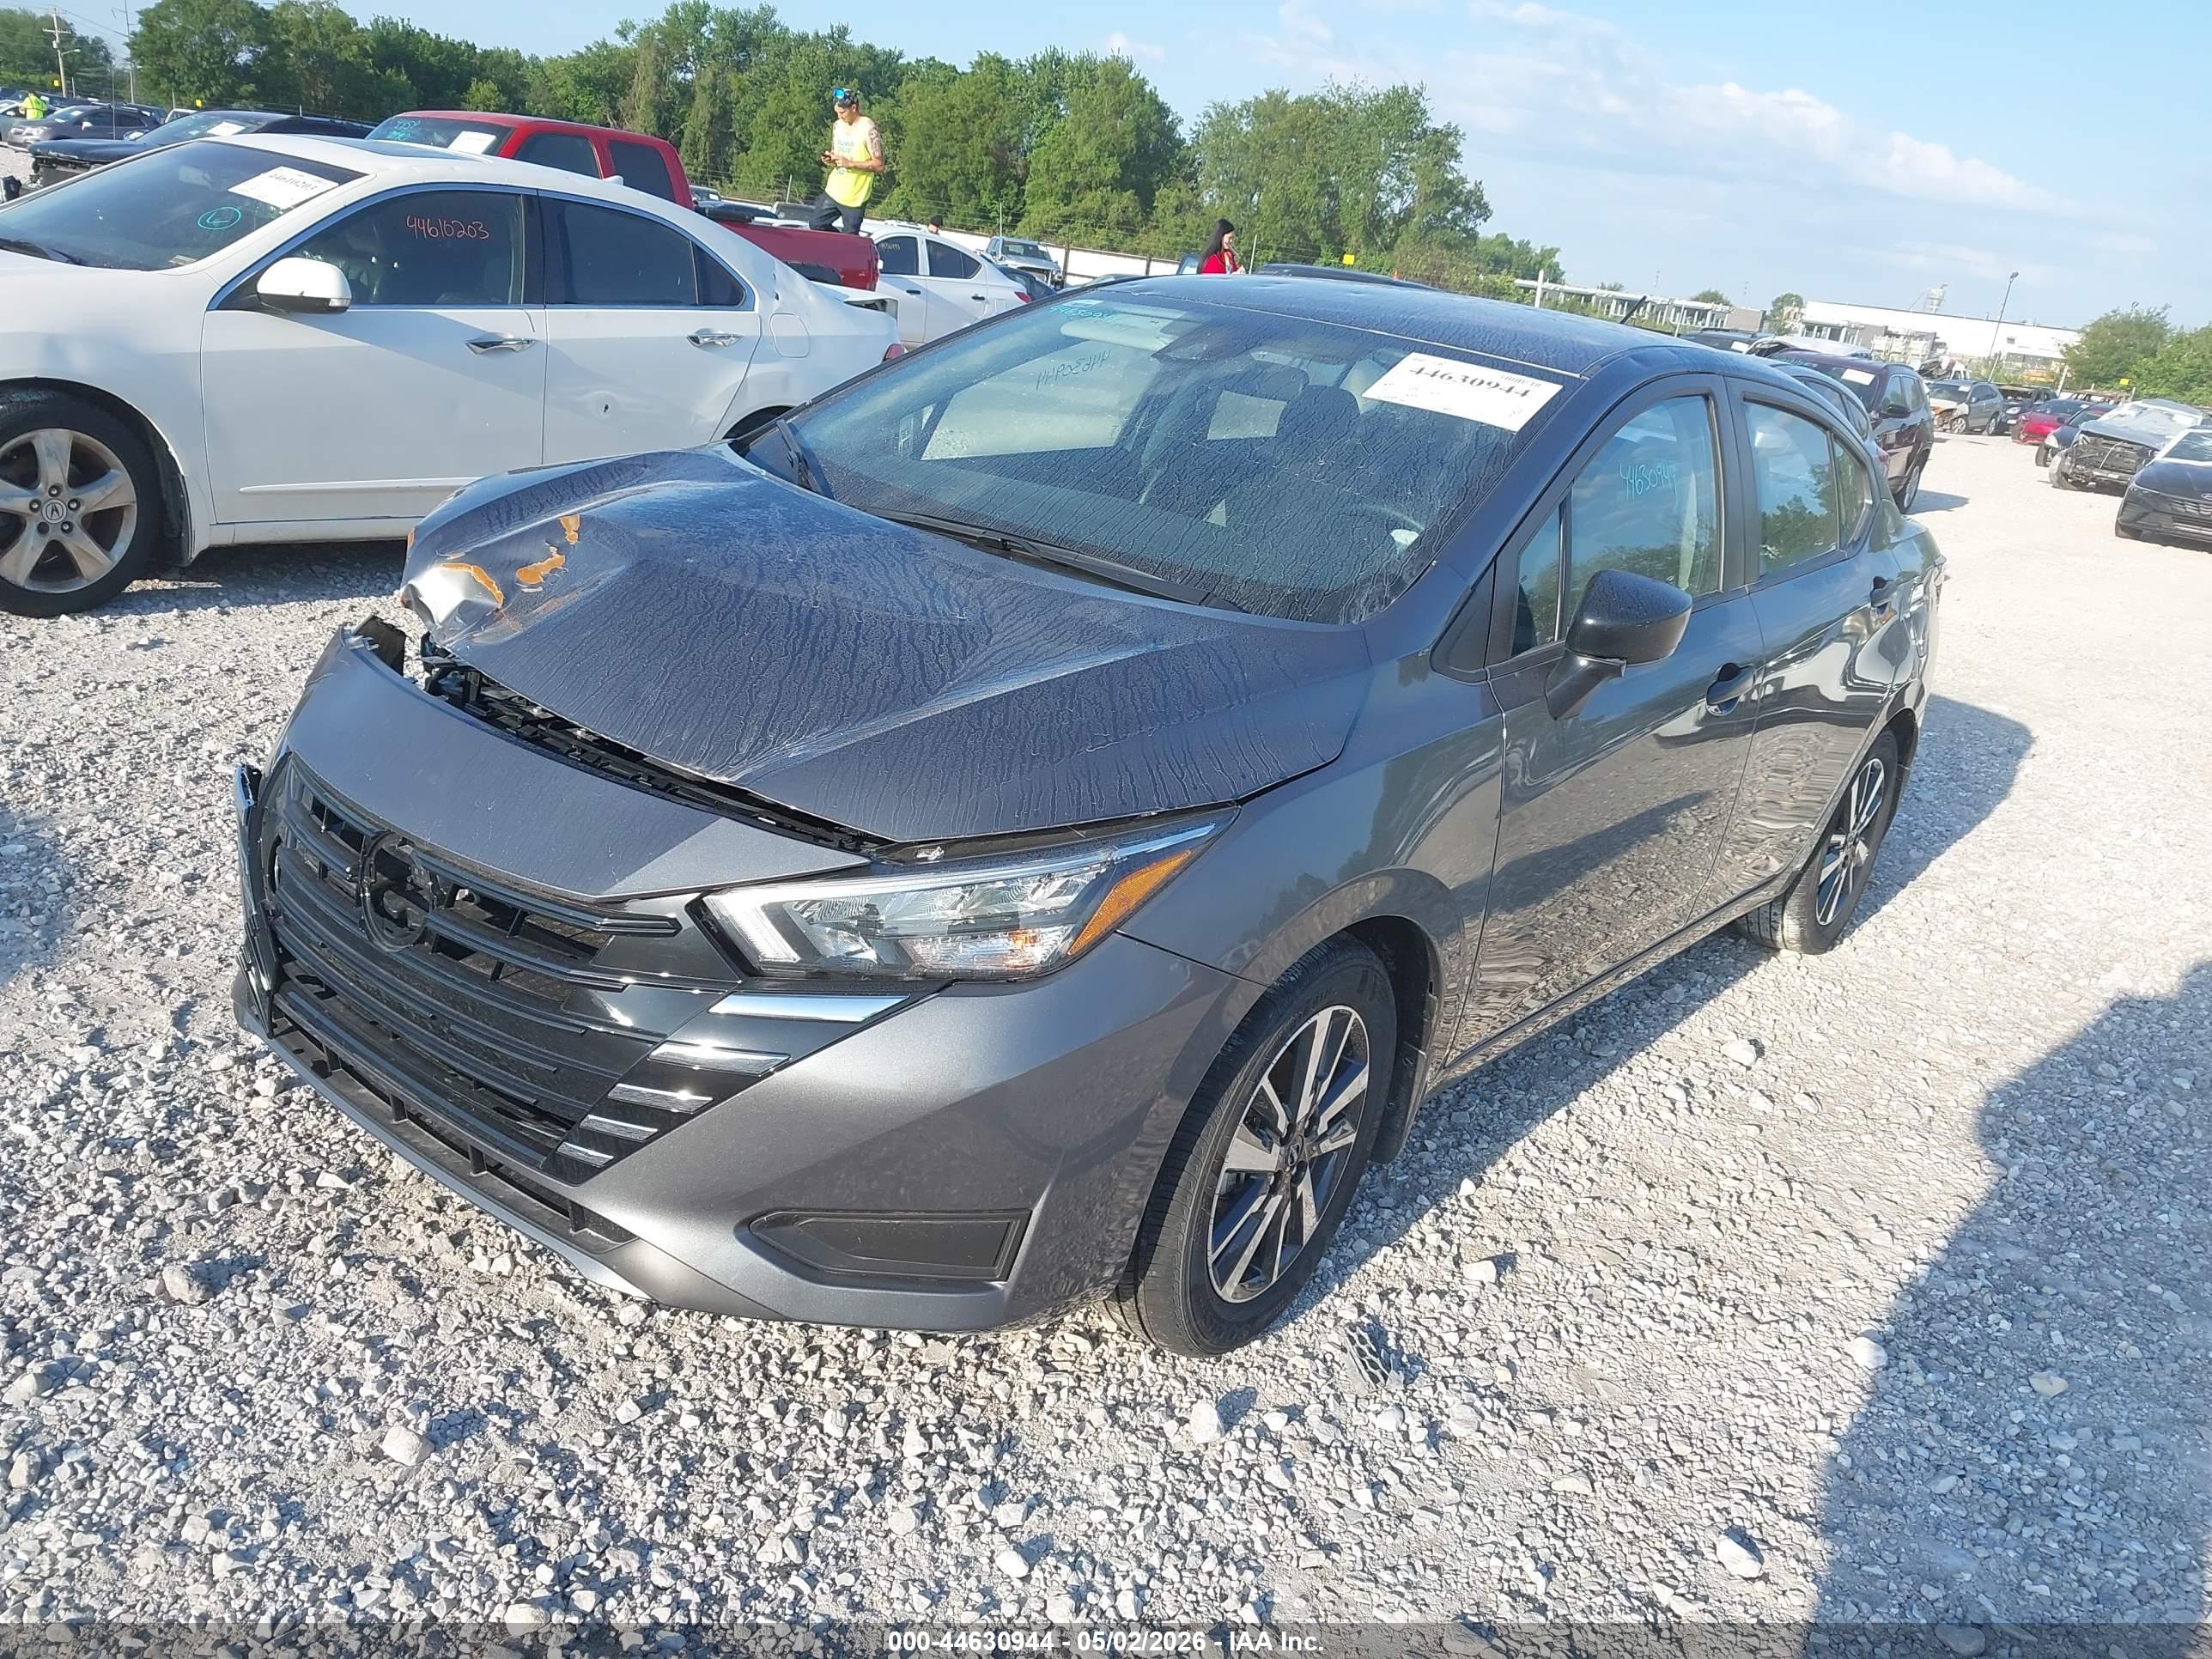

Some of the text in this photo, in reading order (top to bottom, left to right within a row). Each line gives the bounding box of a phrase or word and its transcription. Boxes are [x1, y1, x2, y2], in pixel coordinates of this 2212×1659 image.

[406, 215, 489, 240] 44610203
[1408, 366, 1531, 398] 44630944
[1619, 463, 1677, 500] 44630944
